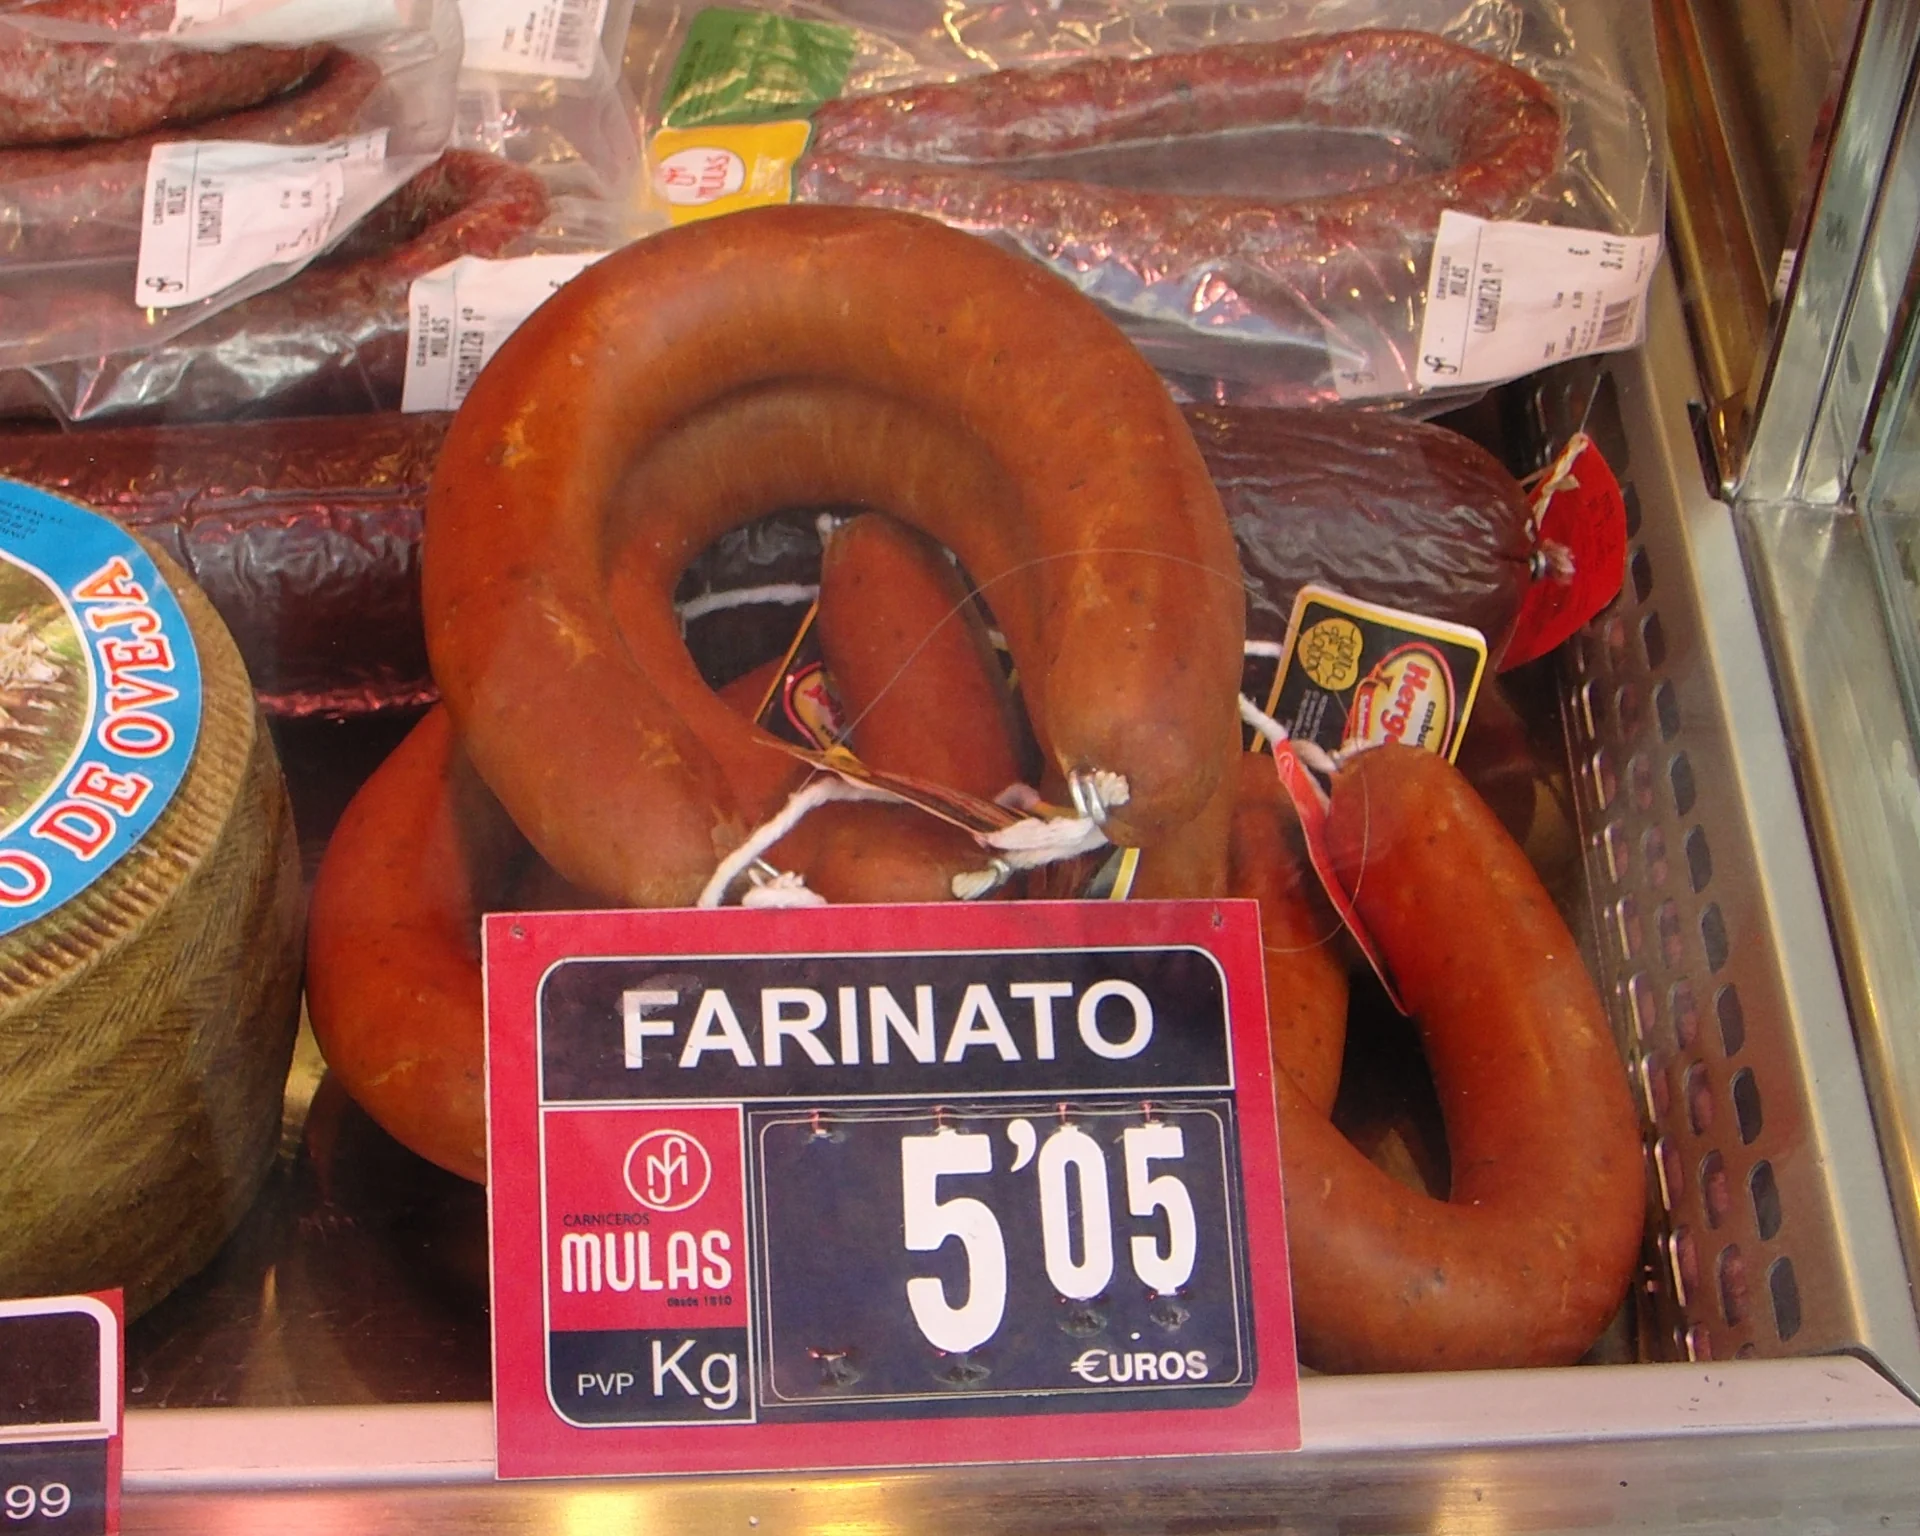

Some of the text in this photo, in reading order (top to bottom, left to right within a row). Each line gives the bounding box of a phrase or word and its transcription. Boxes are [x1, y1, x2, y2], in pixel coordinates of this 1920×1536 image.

[73, 556, 179, 757] OVEJA
[1379, 660, 1432, 747] Herg
[1416, 700, 1437, 749] embu
[31, 762, 153, 861] DE
[622, 980, 1155, 1070] FARINATO
[562, 1212, 651, 1228] CARNICEROS
[560, 1229, 732, 1293] MULAS
[666, 1296, 699, 1308] desde
[576, 1338, 739, 1411] PVP Kg
[1069, 1349, 1210, 1385] €UROS
[5, 1482, 72, 1520] 99
